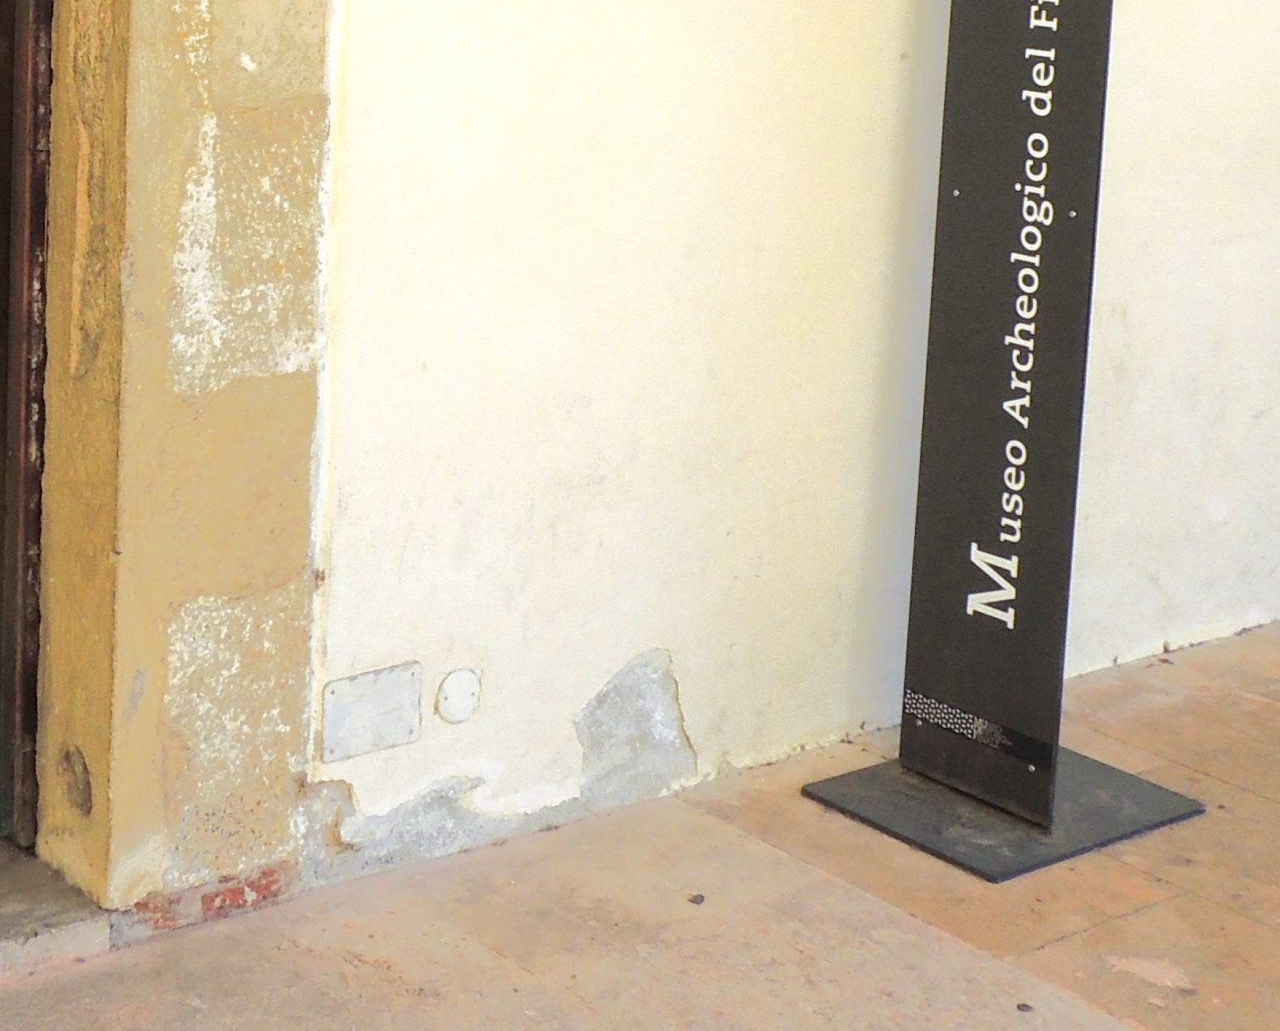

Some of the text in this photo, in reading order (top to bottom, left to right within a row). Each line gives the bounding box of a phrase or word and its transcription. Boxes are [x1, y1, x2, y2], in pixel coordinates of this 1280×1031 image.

[1021, 47, 1057, 117] del
[1002, 131, 1055, 430] Archeologico
[966, 438, 1028, 631] Museo
